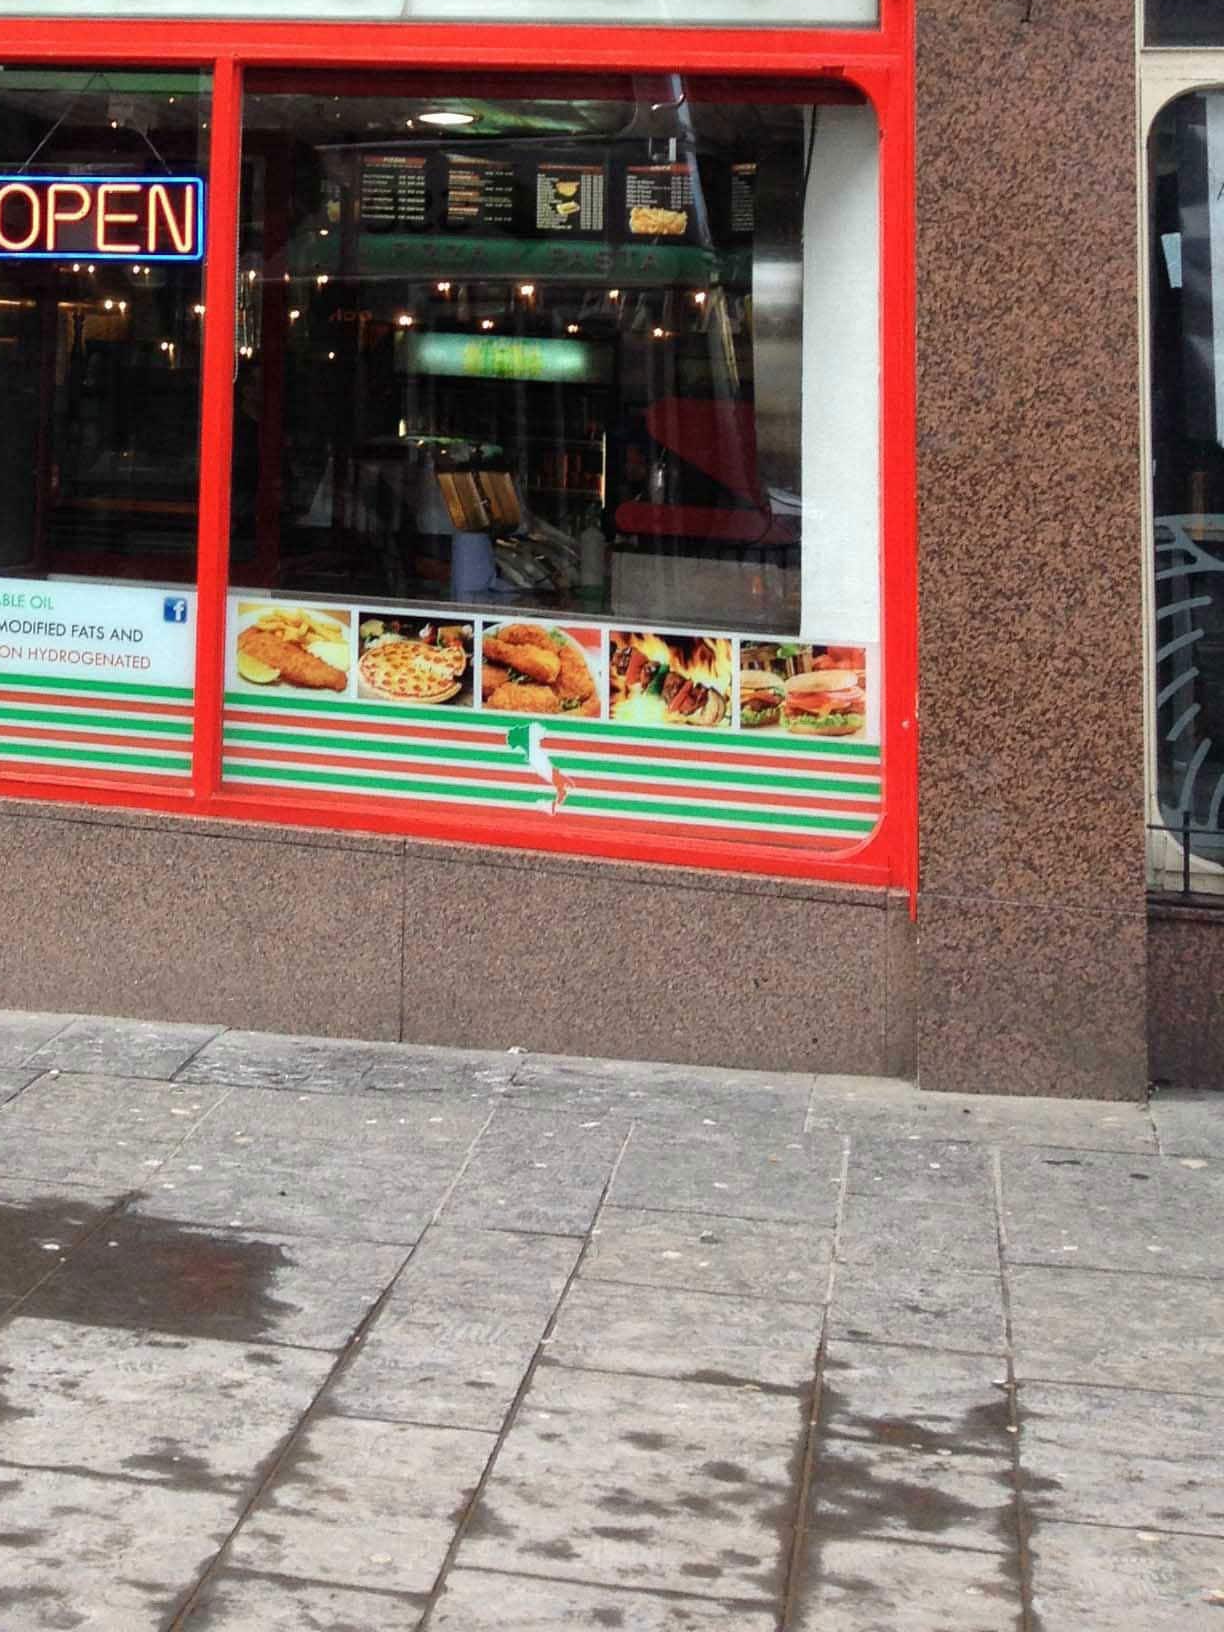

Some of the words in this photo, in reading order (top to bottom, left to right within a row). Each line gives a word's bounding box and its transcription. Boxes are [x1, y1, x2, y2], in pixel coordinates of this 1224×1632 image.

[30, 595, 55, 611] OIL
[72, 624, 105, 641] FATS
[110, 628, 144, 643] AND
[28, 648, 152, 670] HYDROGENATED
